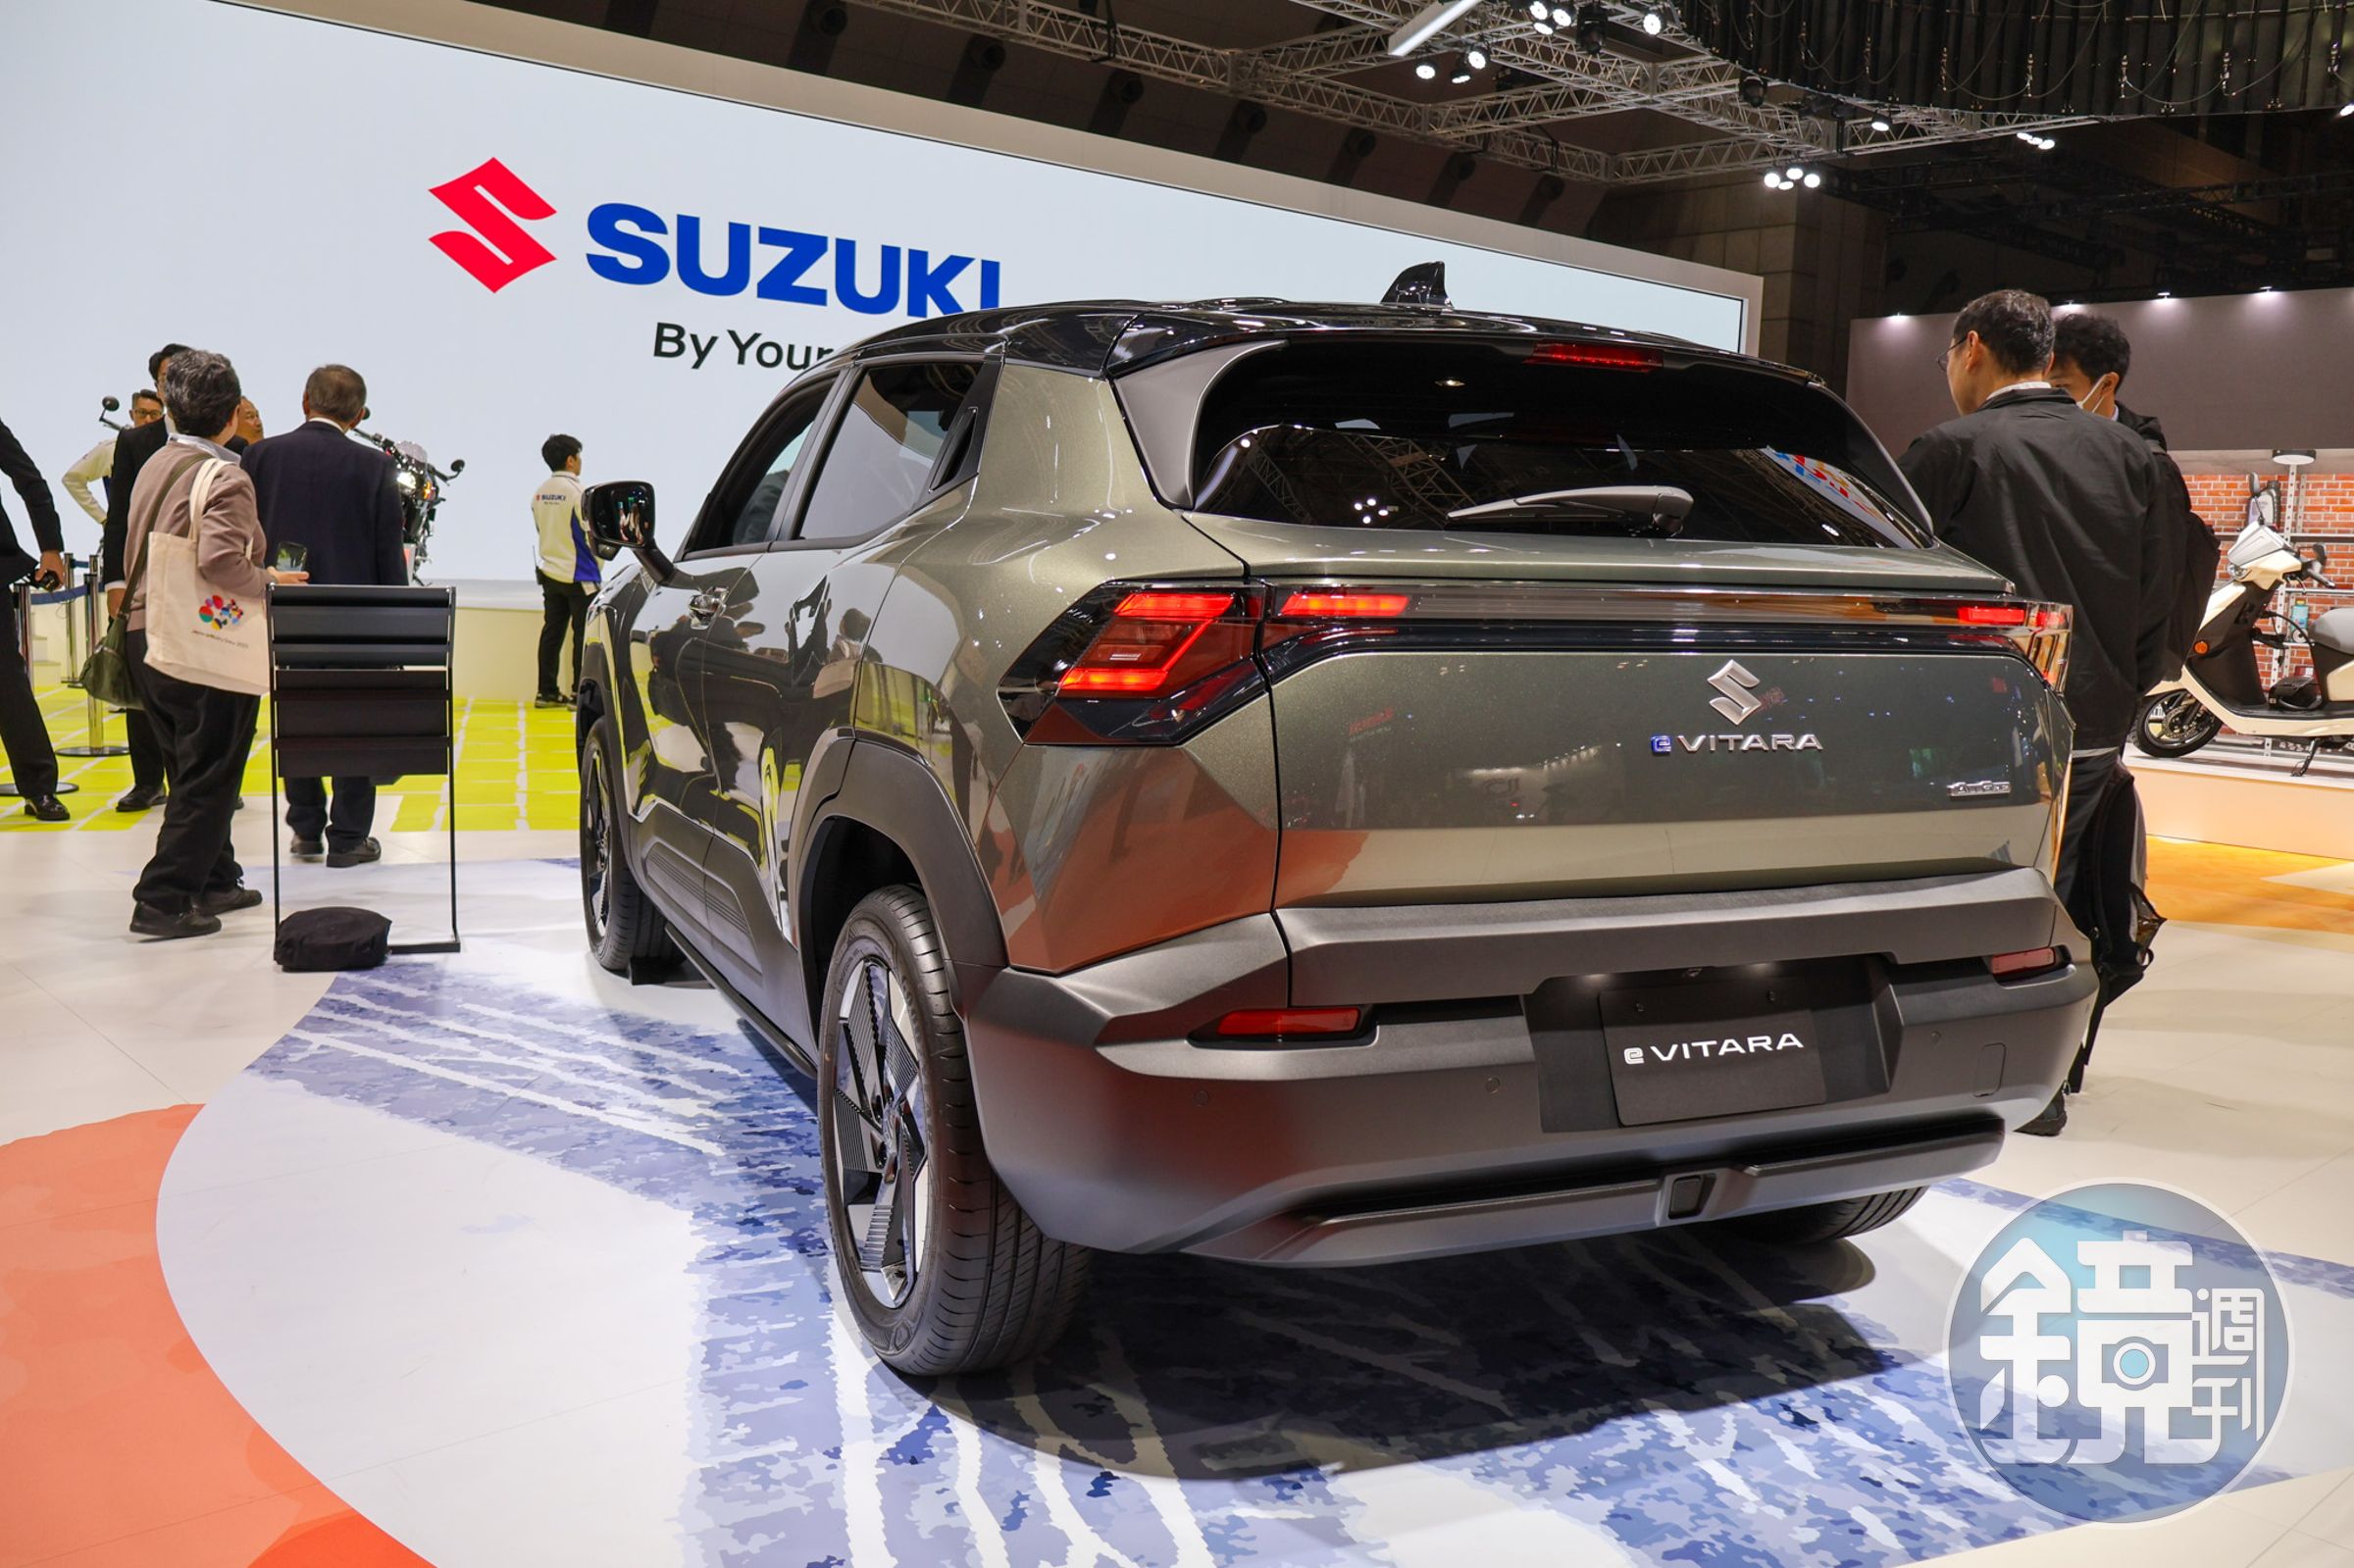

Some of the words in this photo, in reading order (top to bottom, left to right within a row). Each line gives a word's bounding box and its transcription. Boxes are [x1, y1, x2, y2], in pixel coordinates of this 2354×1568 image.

[586, 203, 1001, 319] SUZUKI
[653, 322, 719, 370] By
[727, 329, 834, 371] Your
[1677, 733, 1823, 752] VITARA
[1650, 1033, 1804, 1061] VITARA
